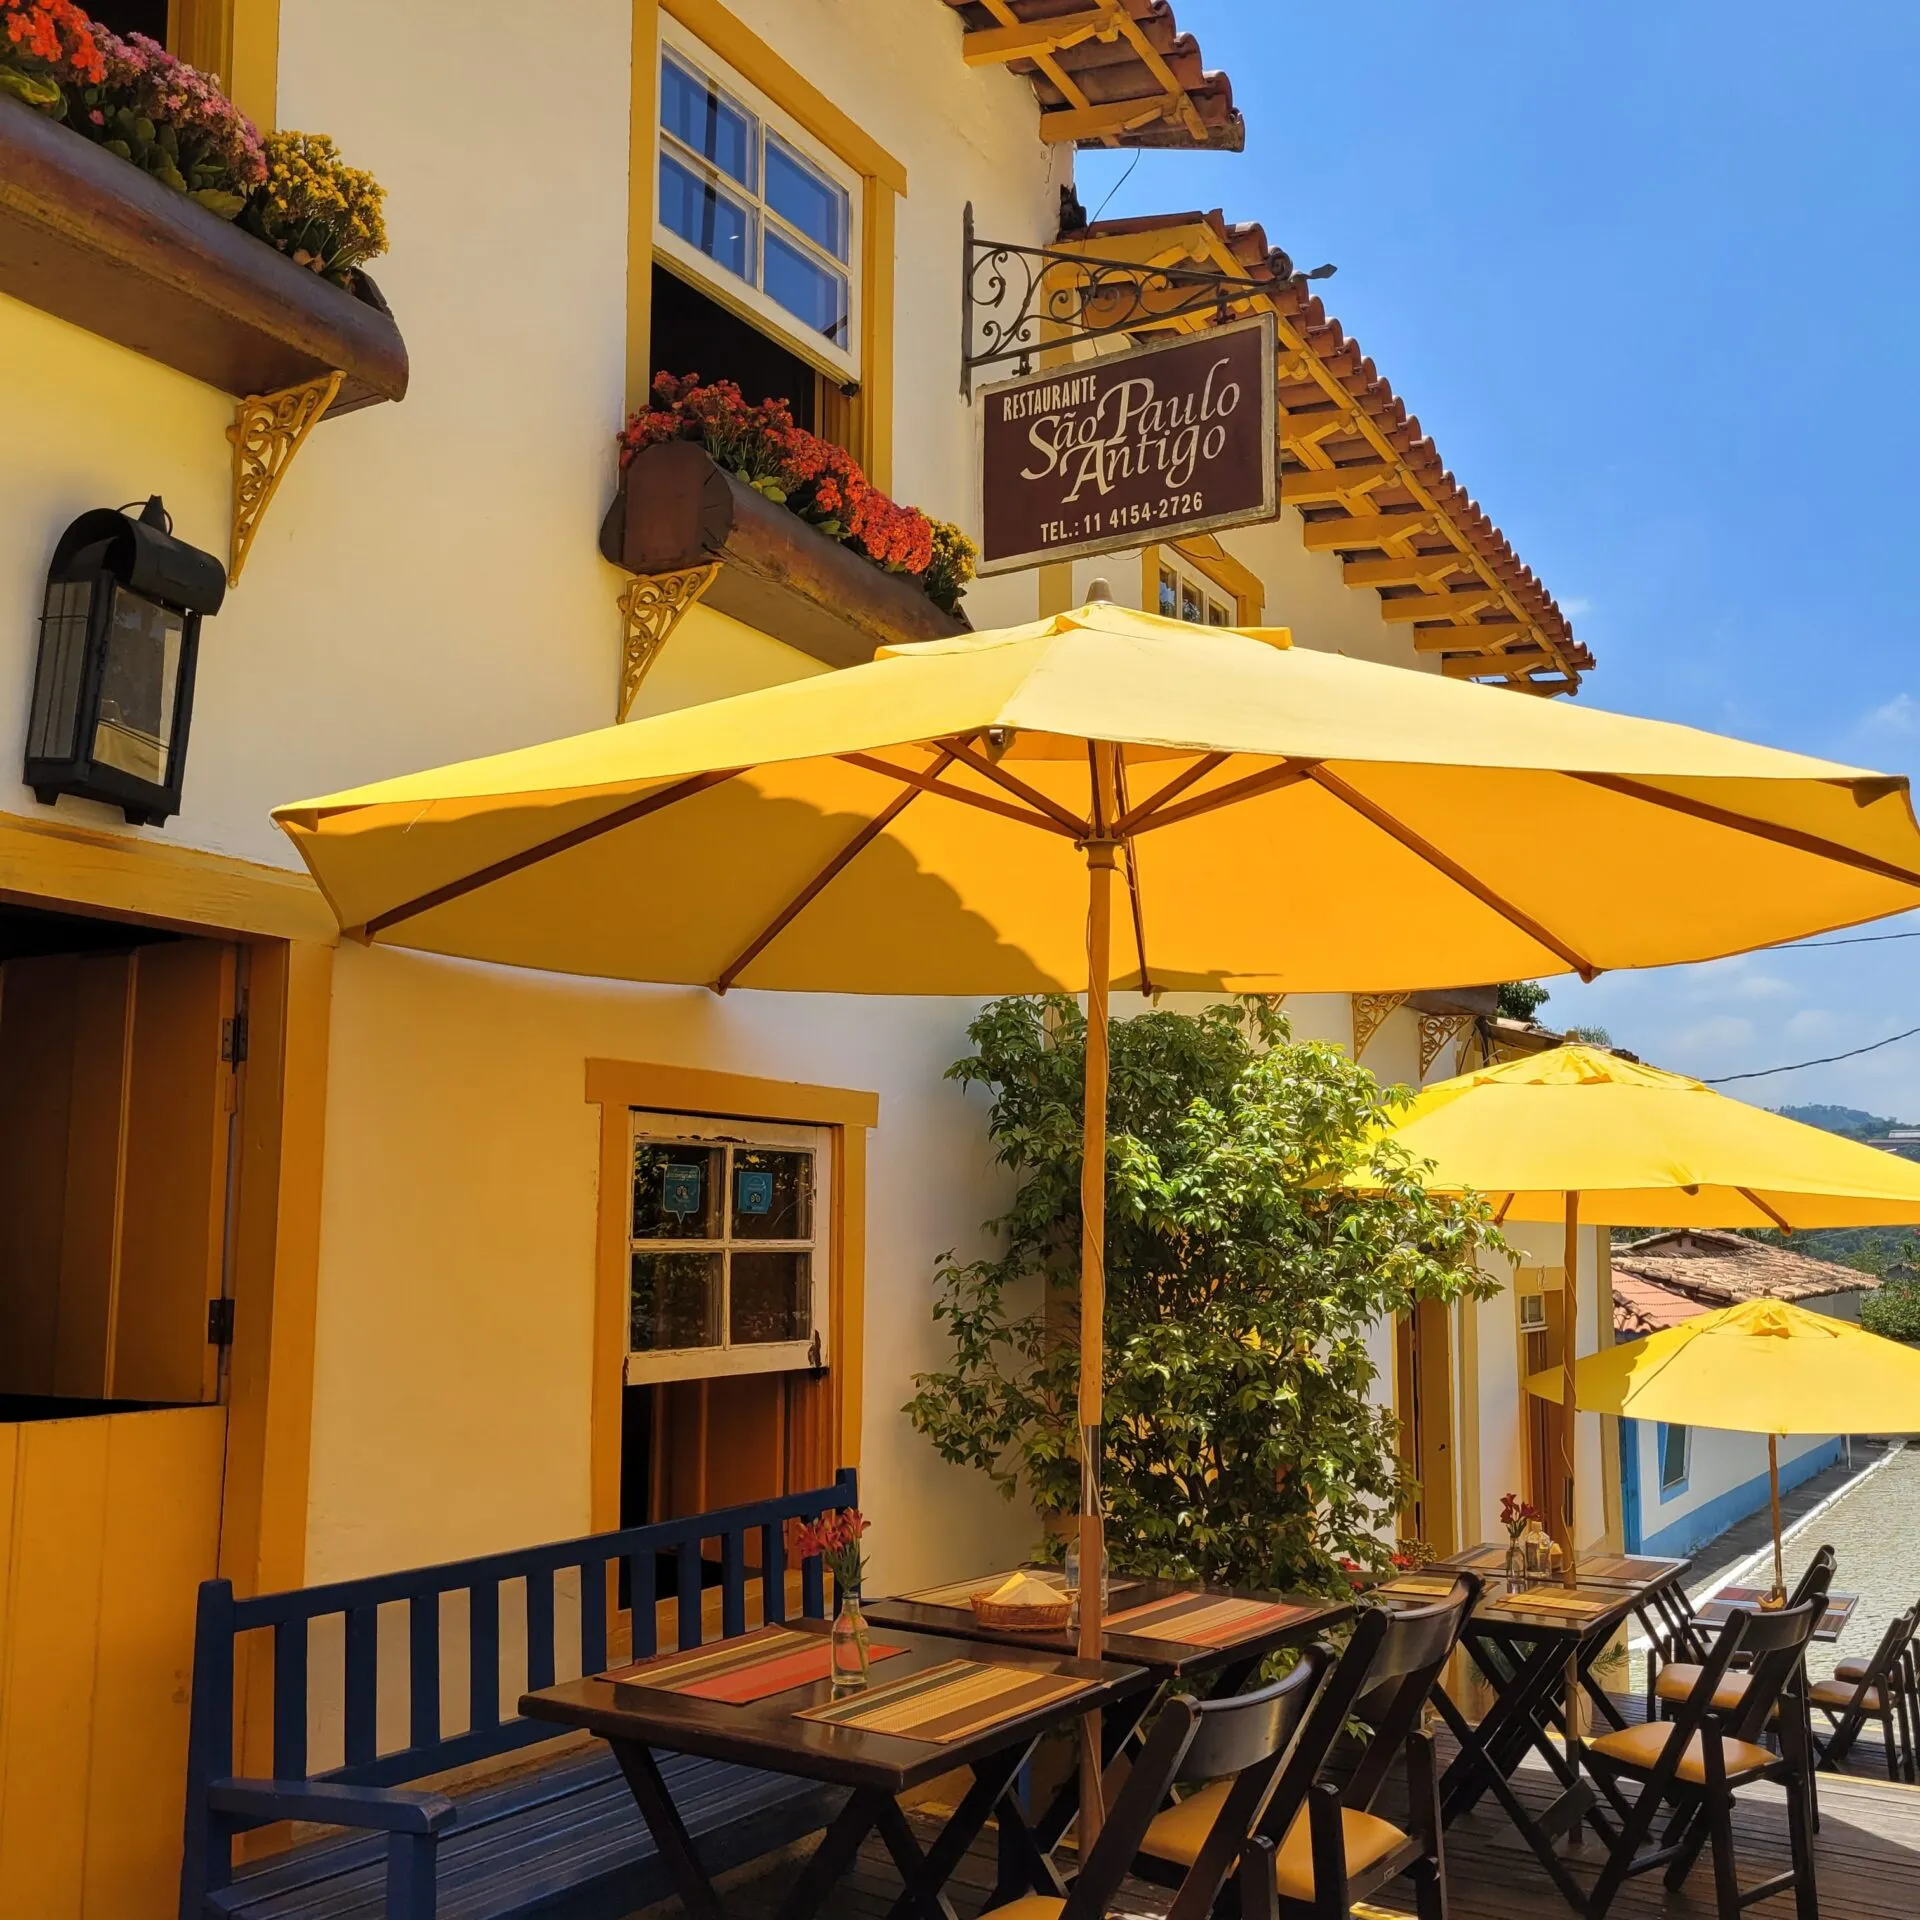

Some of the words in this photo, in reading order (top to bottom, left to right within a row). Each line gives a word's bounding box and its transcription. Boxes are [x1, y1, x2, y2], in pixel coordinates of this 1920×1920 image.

[1003, 375, 1096, 422] RESTAURANTE
[1020, 412, 1097, 480] São
[1097, 357, 1240, 446] Paulo
[1060, 424, 1226, 504] Antigo
[1040, 520, 1079, 543] TEL.:
[1083, 512, 1101, 534] 11
[1109, 491, 1203, 529] 4154-2726
